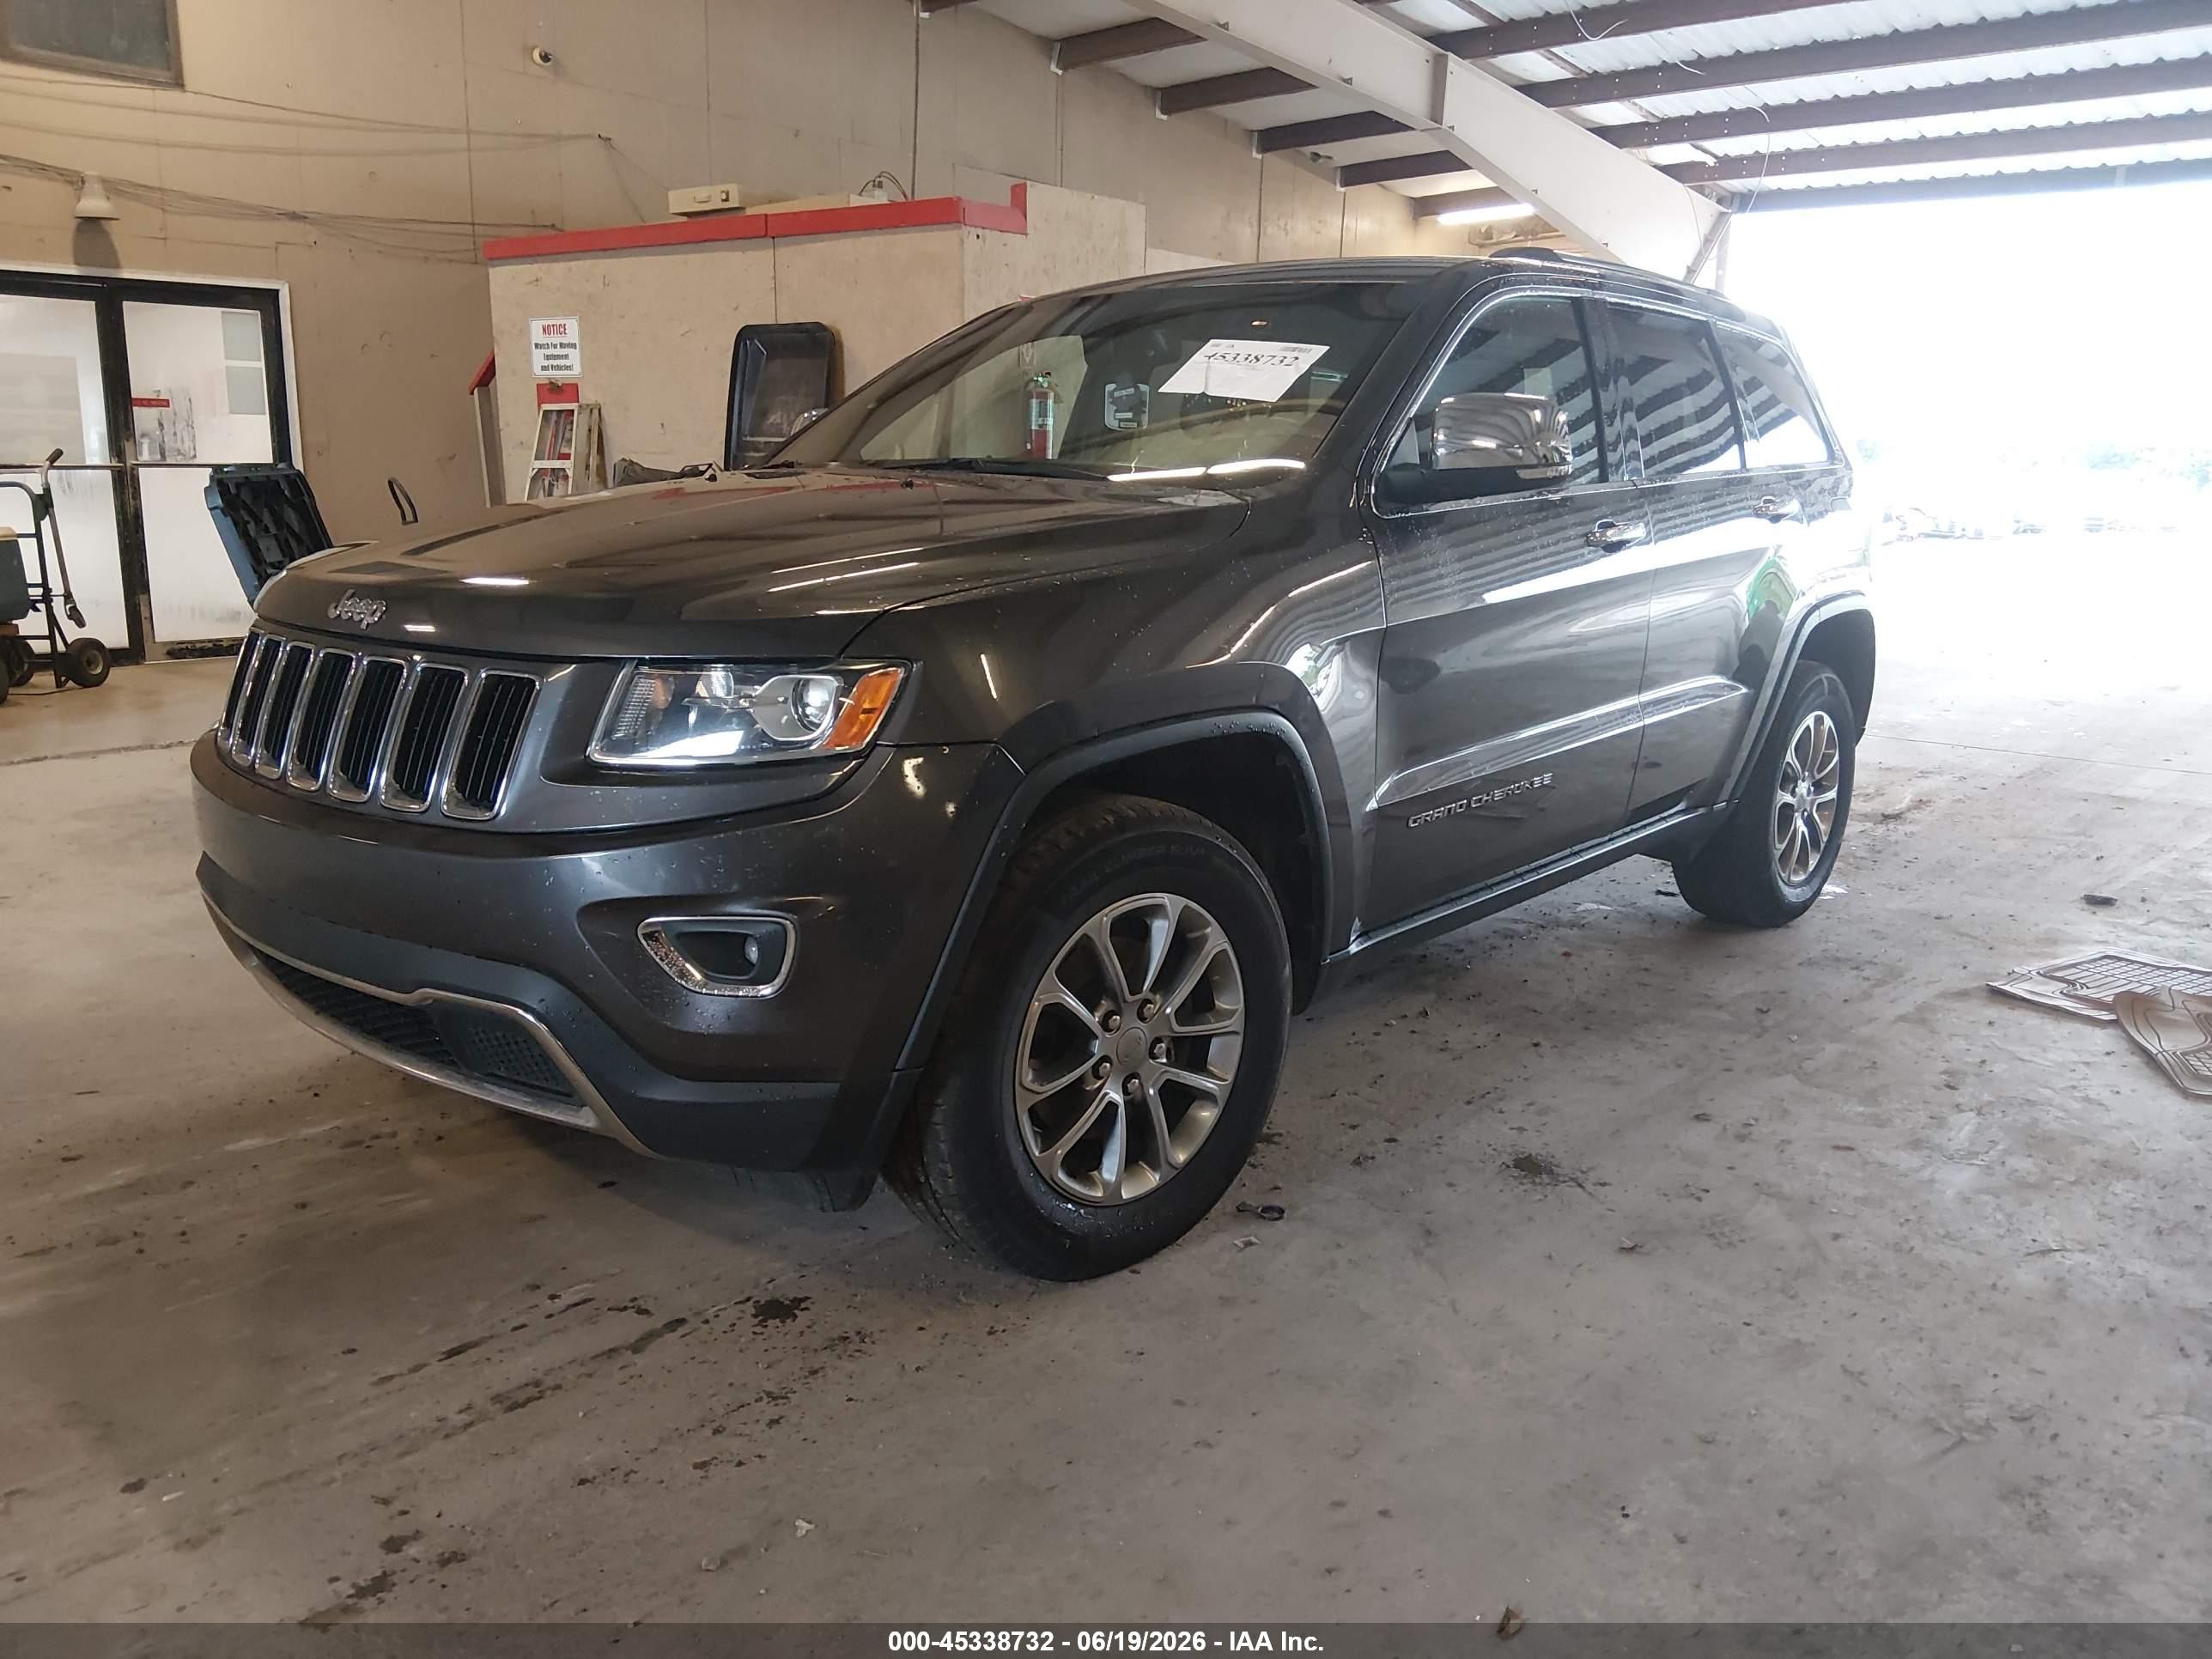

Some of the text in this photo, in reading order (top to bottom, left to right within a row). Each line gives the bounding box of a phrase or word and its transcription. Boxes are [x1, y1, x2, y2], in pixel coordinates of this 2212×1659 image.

[542, 323, 568, 336] NOTICE
[1204, 352, 1299, 367] 45338732
[327, 589, 387, 630] Jeep
[1407, 772, 1553, 829] GRAND CHEROKEE
